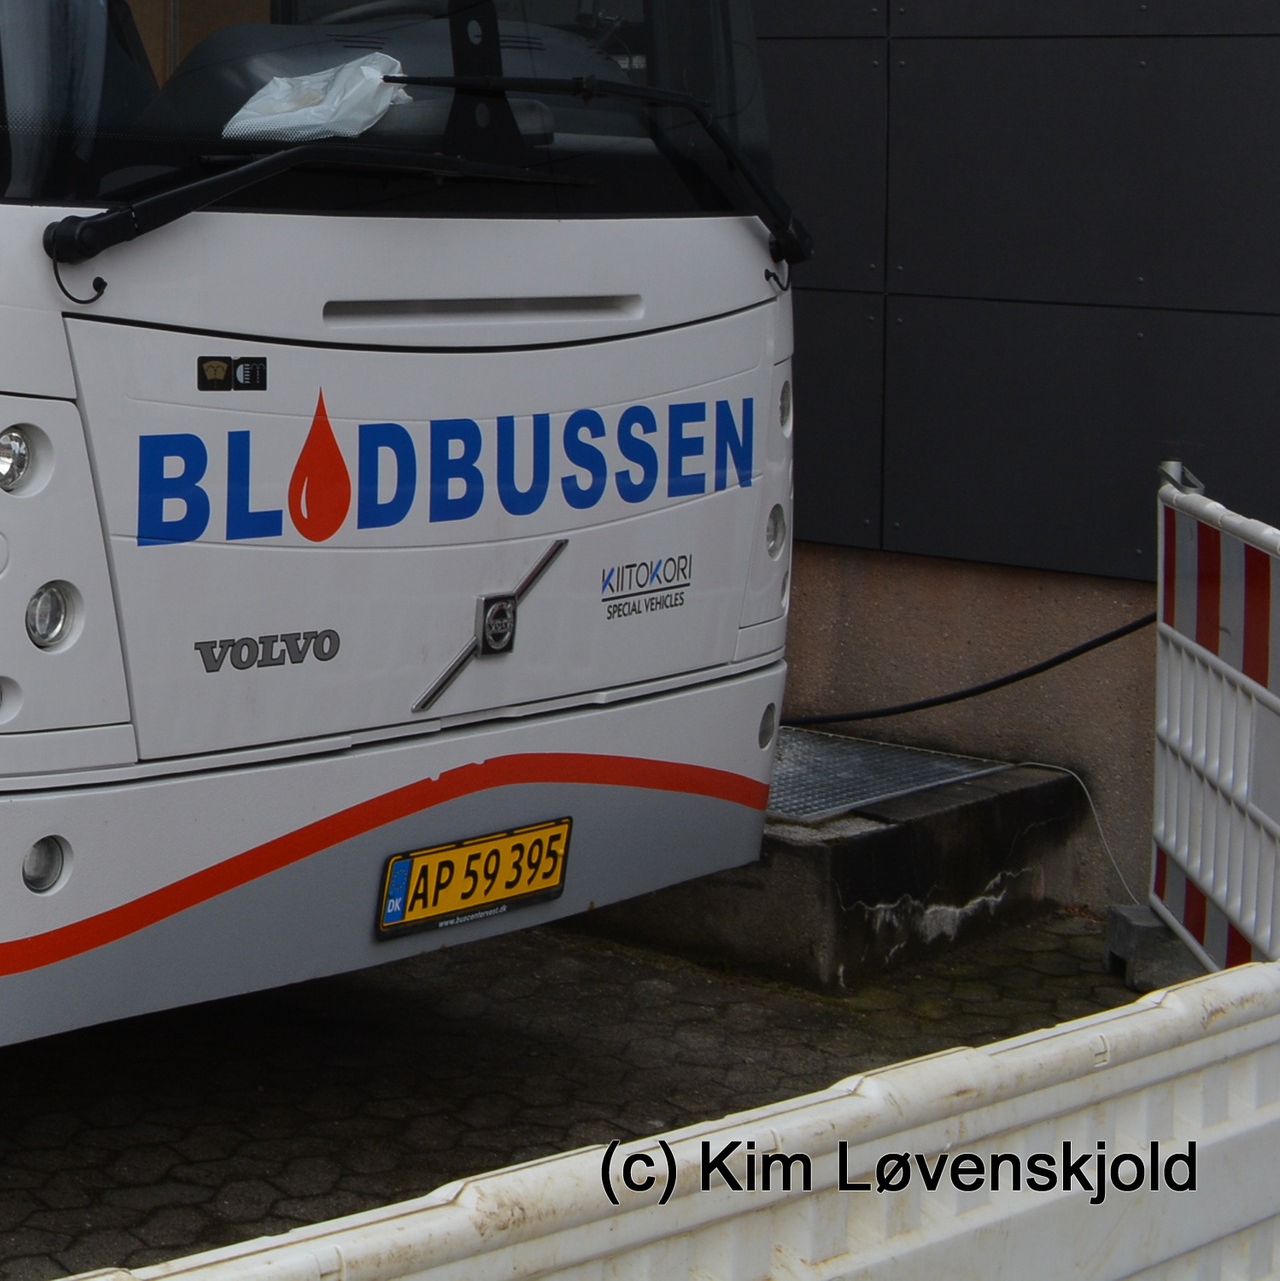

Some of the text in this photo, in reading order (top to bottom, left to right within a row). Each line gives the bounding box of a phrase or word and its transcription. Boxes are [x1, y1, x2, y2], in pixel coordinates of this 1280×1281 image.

[601, 554, 692, 594] KIITOKORI
[606, 592, 685, 620] SPECIAL VEHICLES
[195, 629, 340, 673] VOLVO
[408, 833, 562, 912] AP 59 395
[387, 897, 402, 913] DK
